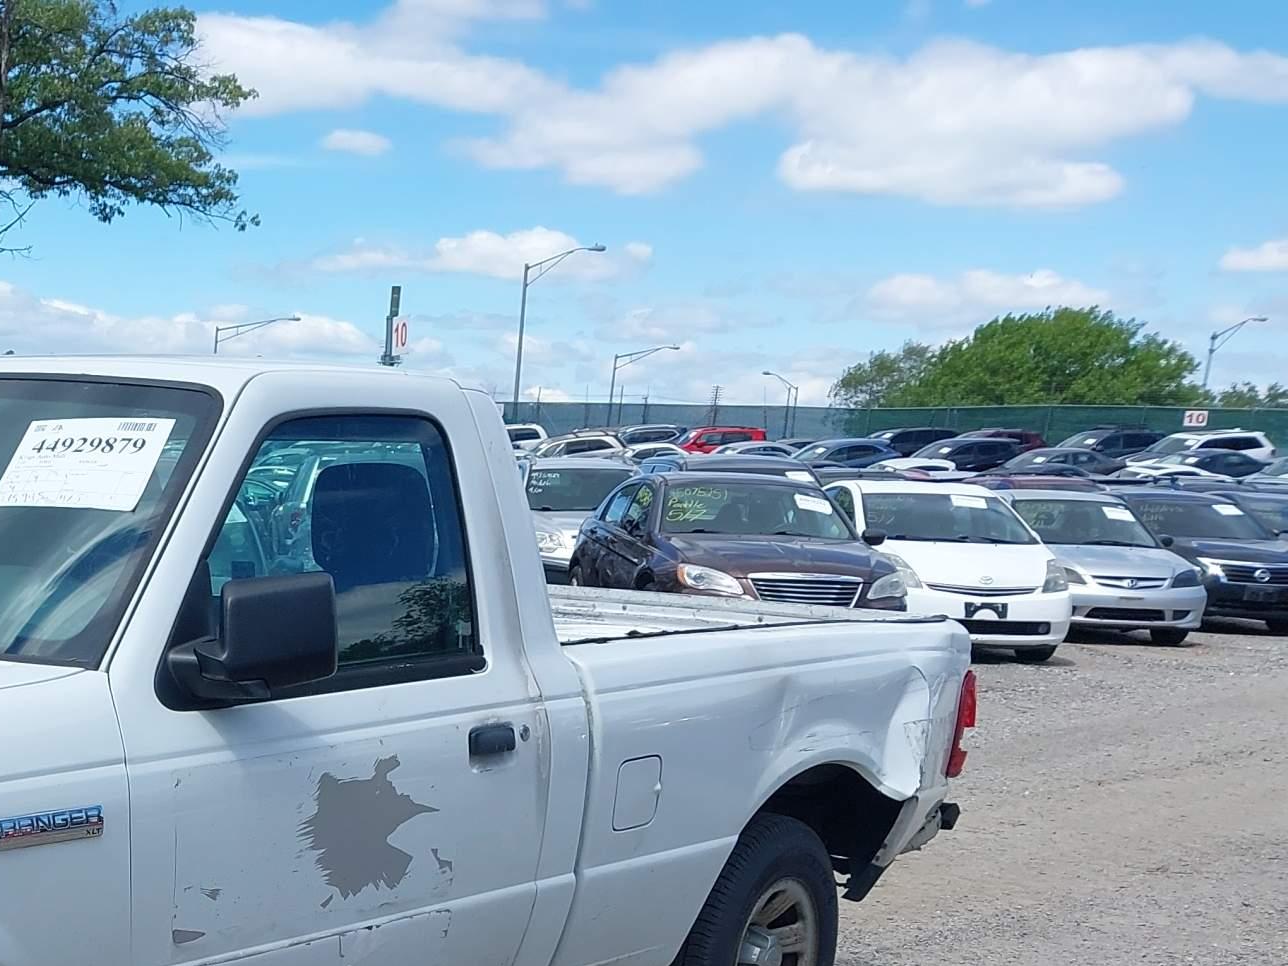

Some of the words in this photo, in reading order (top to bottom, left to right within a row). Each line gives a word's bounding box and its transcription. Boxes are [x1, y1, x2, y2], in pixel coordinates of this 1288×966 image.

[394, 322, 408, 348] 10
[1185, 412, 1206, 424] 10
[31, 436, 147, 455] 44929879
[85, 827, 102, 837] XLT
